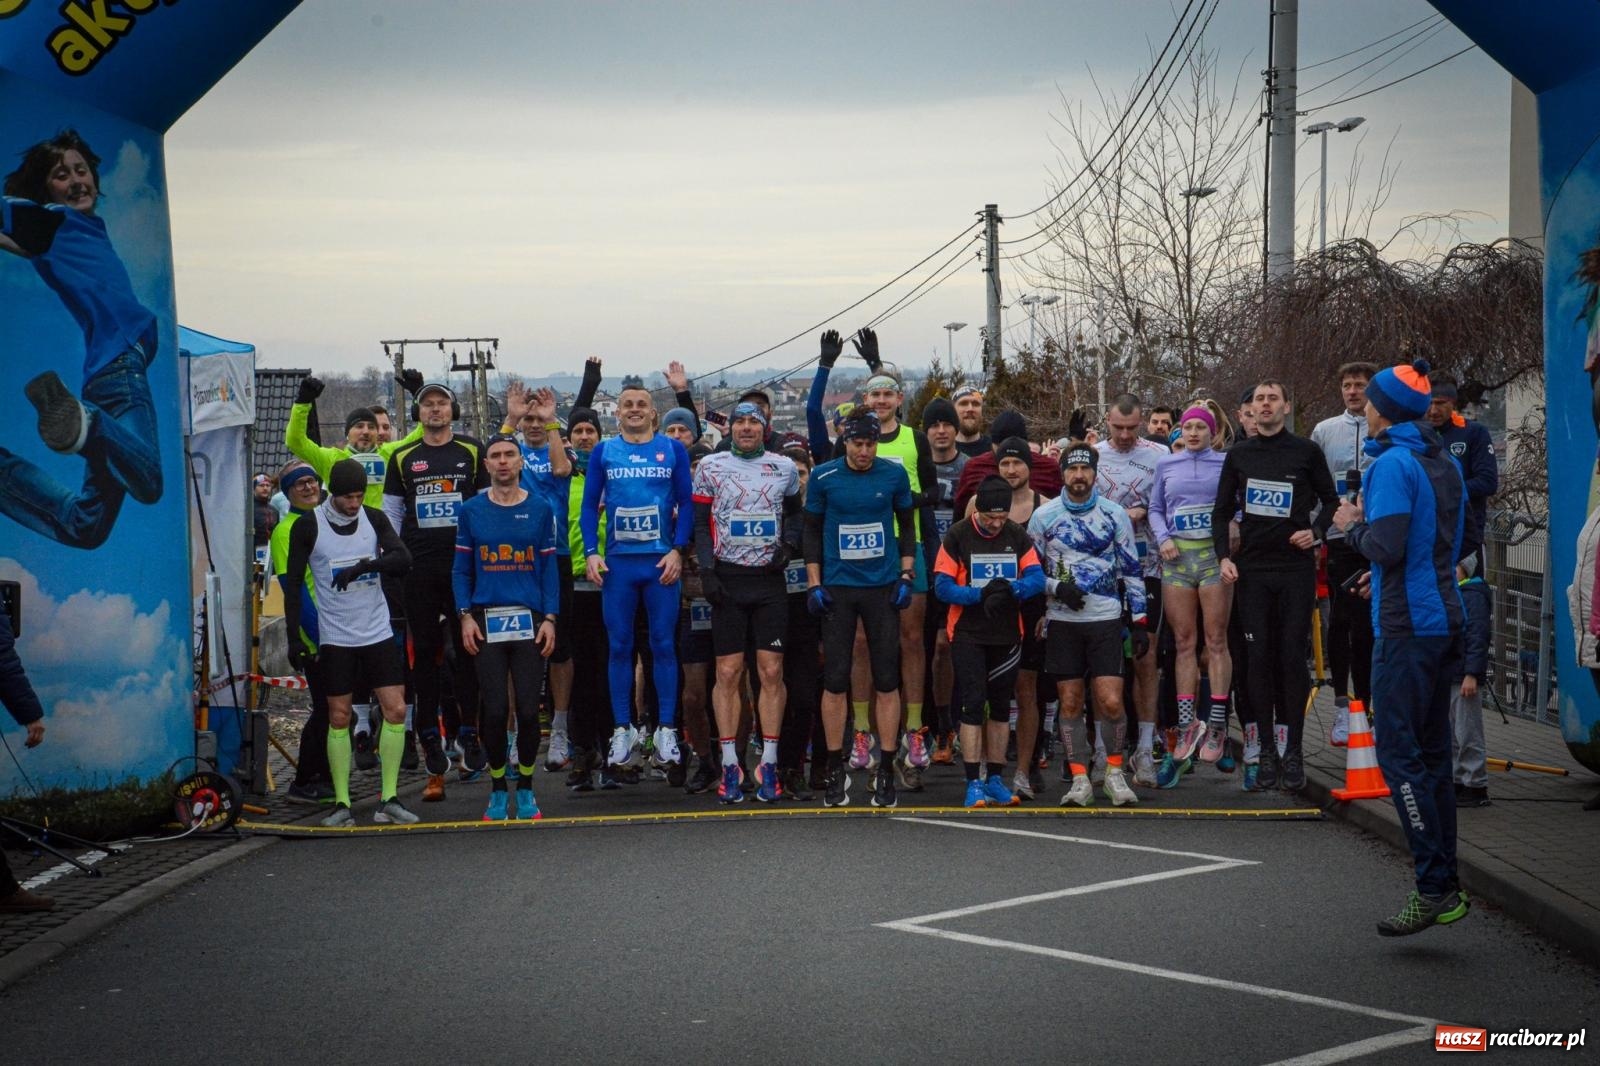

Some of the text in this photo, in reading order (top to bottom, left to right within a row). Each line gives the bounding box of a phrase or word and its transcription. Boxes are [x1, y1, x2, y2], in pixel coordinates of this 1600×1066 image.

[607, 466, 672, 480] RUNNERS
[1252, 490, 1284, 507] 220
[425, 502, 455, 518] 155
[623, 516, 652, 531] 114
[743, 521, 763, 536] 16
[1182, 513, 1212, 530] 153
[847, 533, 878, 549] 218
[985, 563, 1004, 578] 31
[499, 615, 520, 631] 74
